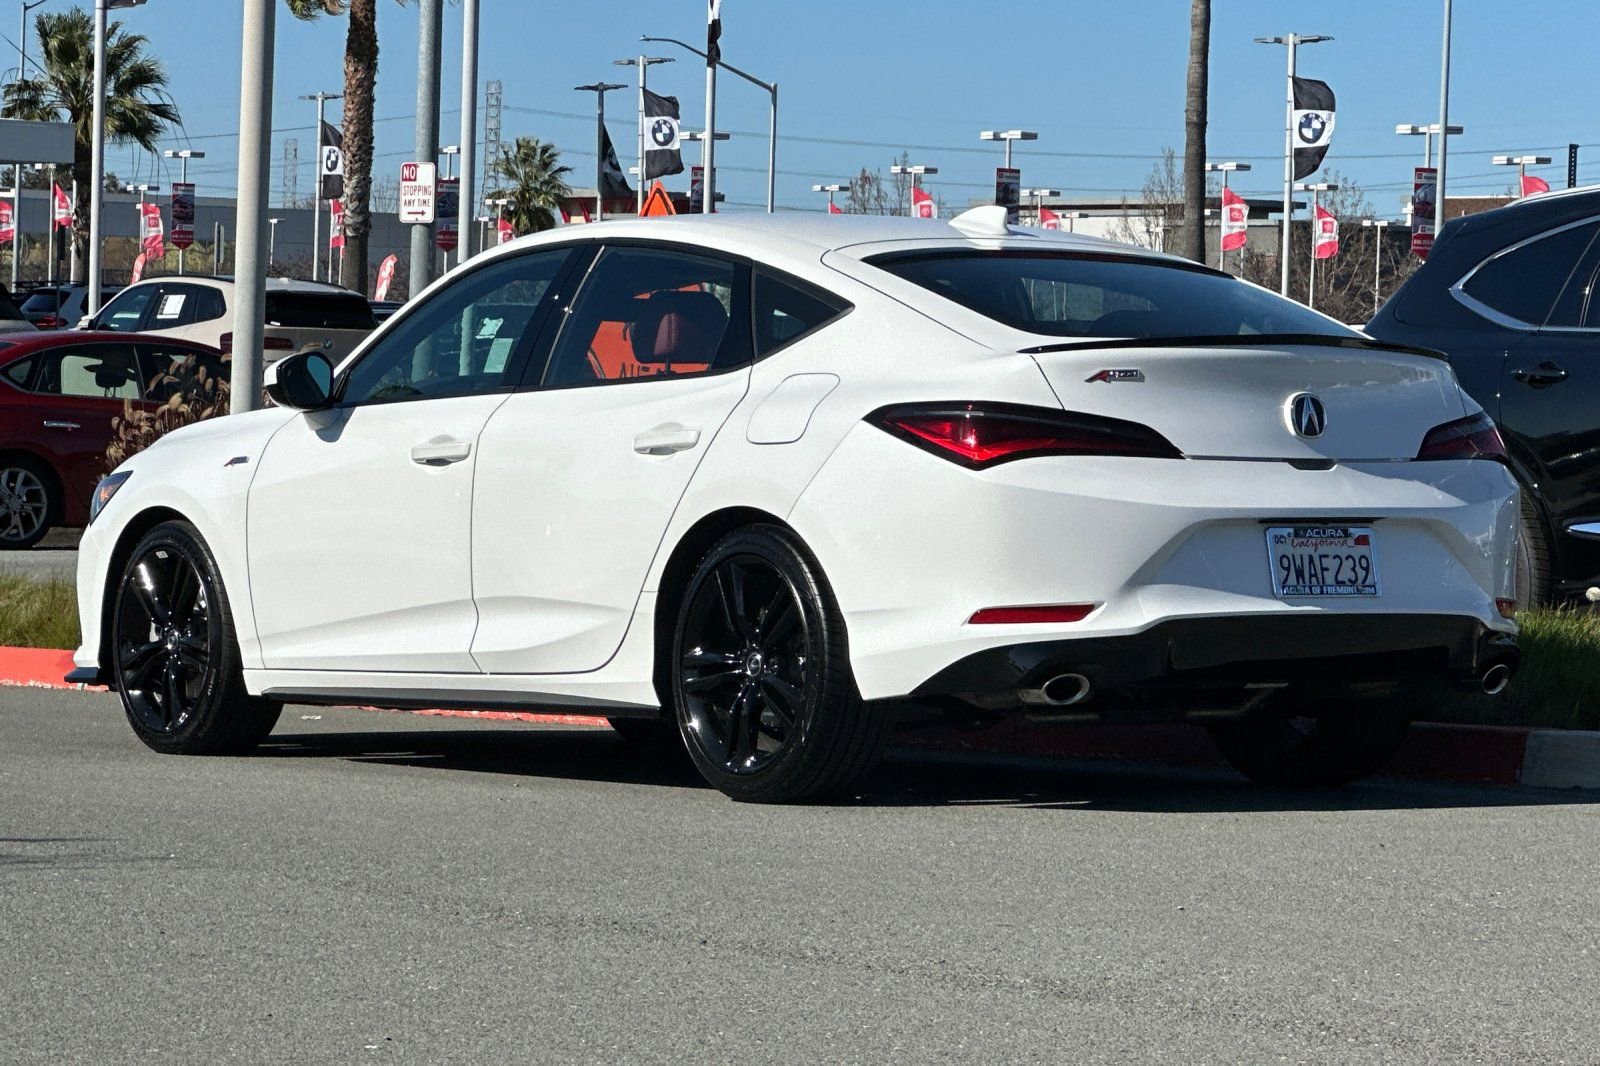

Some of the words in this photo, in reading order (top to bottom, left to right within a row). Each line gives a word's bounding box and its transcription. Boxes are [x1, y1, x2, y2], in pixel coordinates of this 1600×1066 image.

[403, 166, 416, 180] NO
[403, 185, 432, 196] STOPPING
[403, 199, 416, 207] ANY
[417, 199, 431, 207] TIME
[1306, 529, 1345, 537] ACURA
[1291, 537, 1355, 551] California
[1279, 554, 1370, 585] 9WAF239
